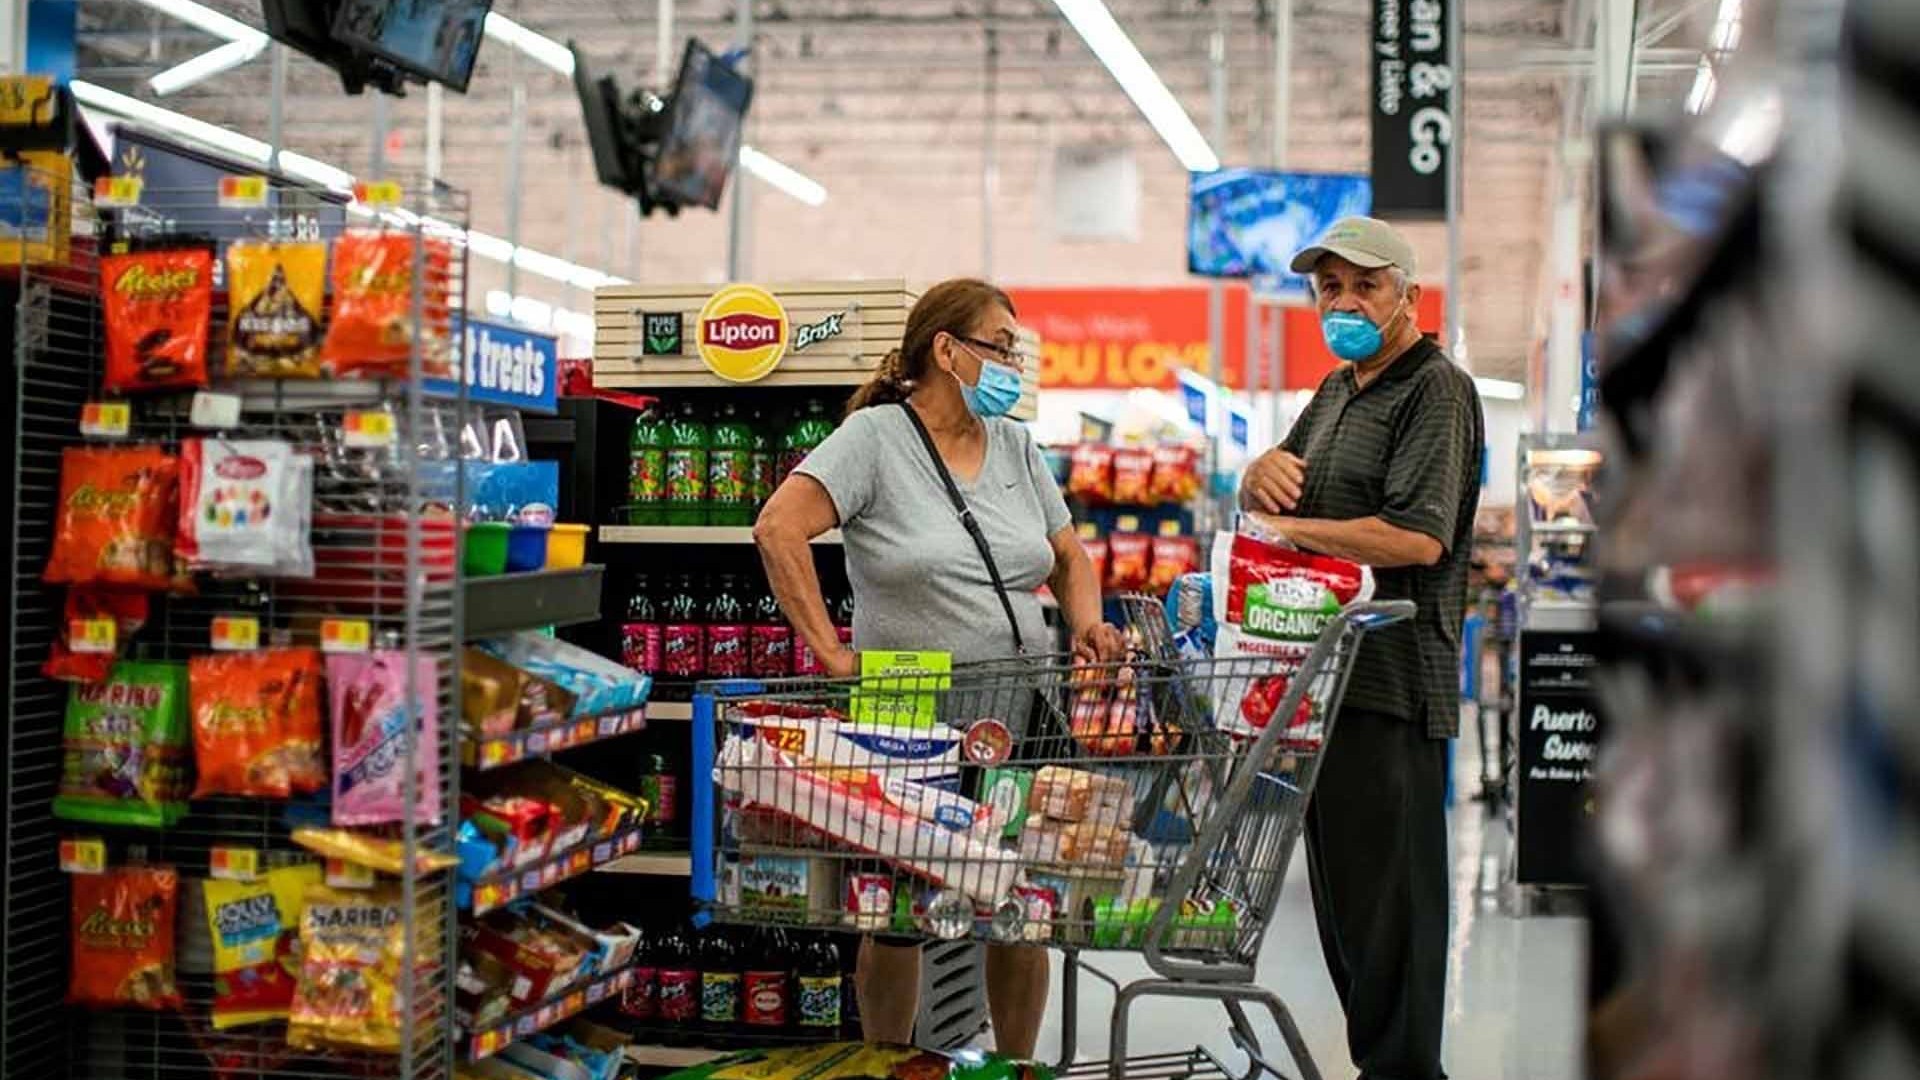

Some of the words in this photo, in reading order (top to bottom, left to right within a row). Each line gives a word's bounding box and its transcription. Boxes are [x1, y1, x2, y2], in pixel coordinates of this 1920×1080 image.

[1409, 0, 1442, 51] an
[1379, 59, 1406, 115] Listo
[1409, 61, 1451, 98] &
[1409, 106, 1452, 174] Go
[709, 321, 776, 345] Lipton
[796, 313, 843, 349] Brisk
[479, 329, 546, 397] treats
[1039, 341, 1099, 385] OU
[1529, 703, 1597, 732] Puerto
[779, 730, 802, 749] 72
